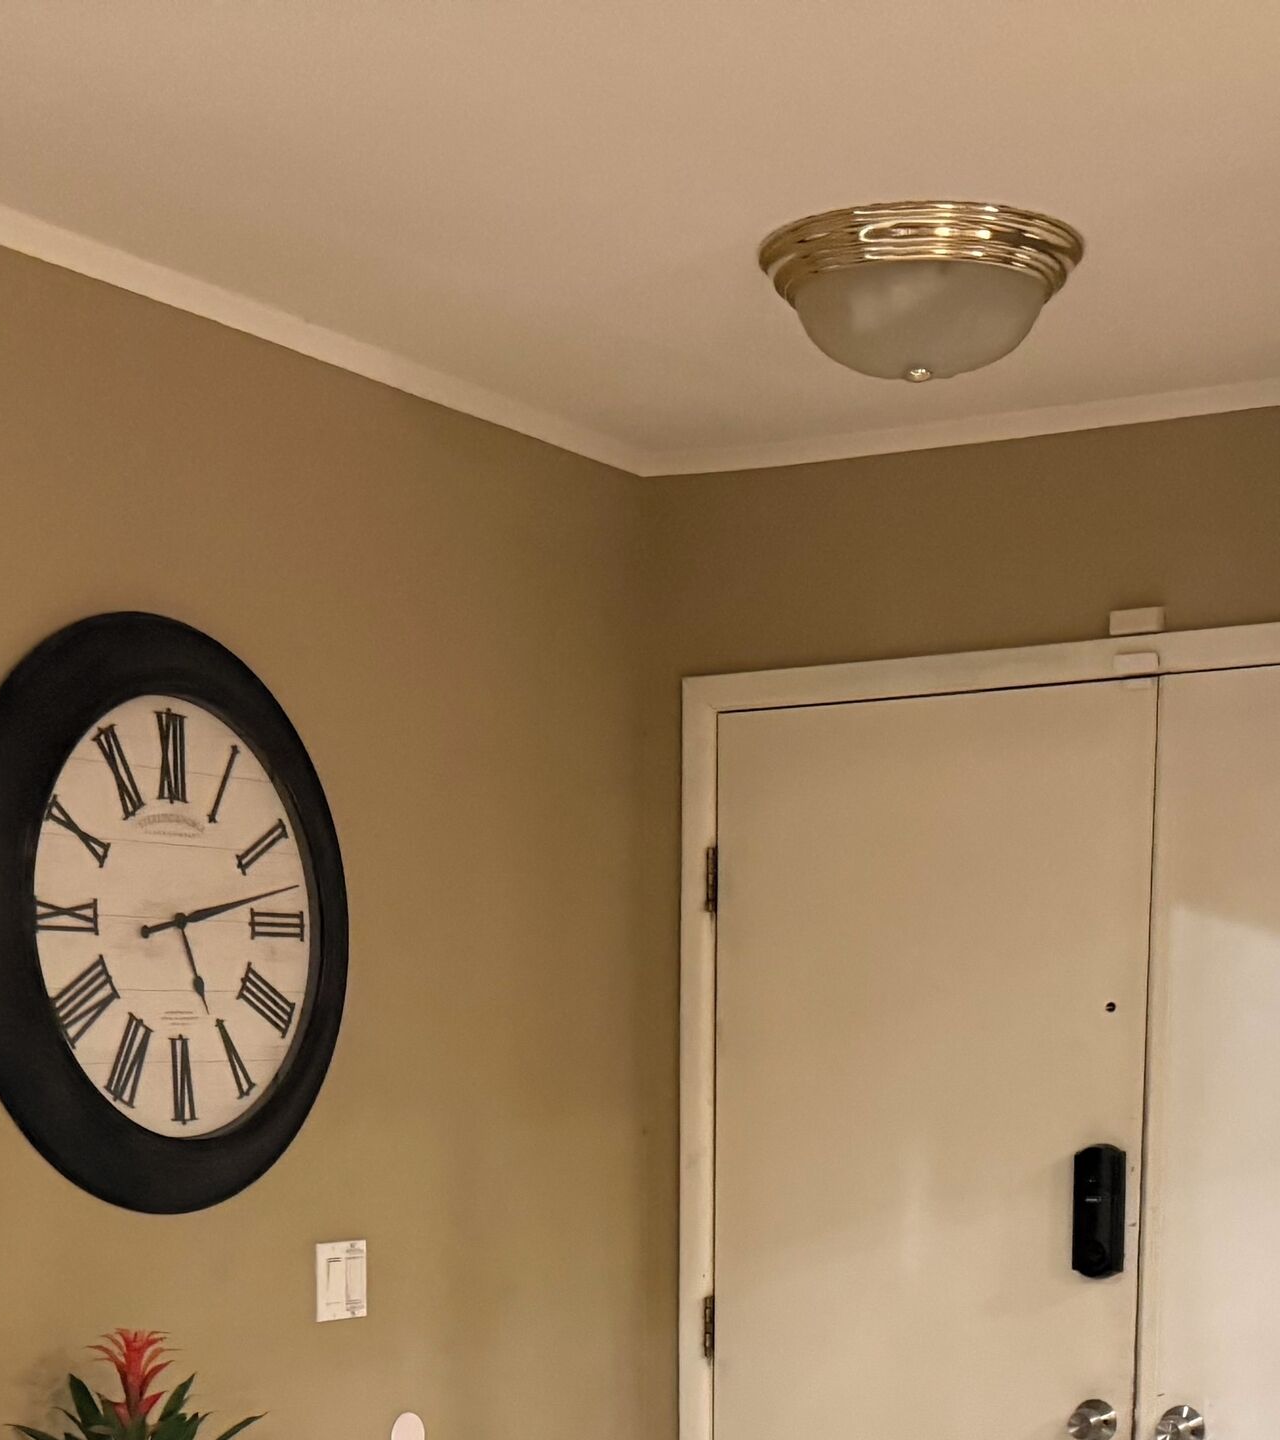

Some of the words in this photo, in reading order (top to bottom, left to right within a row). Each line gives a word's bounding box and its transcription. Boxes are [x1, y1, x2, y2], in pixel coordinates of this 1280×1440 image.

[91, 723, 146, 820] XI
[153, 707, 189, 805] XII
[207, 744, 240, 823] I
[44, 794, 111, 868] X
[235, 818, 288, 876] II
[34, 897, 99, 936] IX
[248, 907, 304, 942] III
[48, 954, 120, 1050] VIII
[236, 961, 295, 1039] IIII
[104, 1011, 154, 1108] VII
[168, 1033, 199, 1126] VI
[215, 1017, 257, 1100] V
